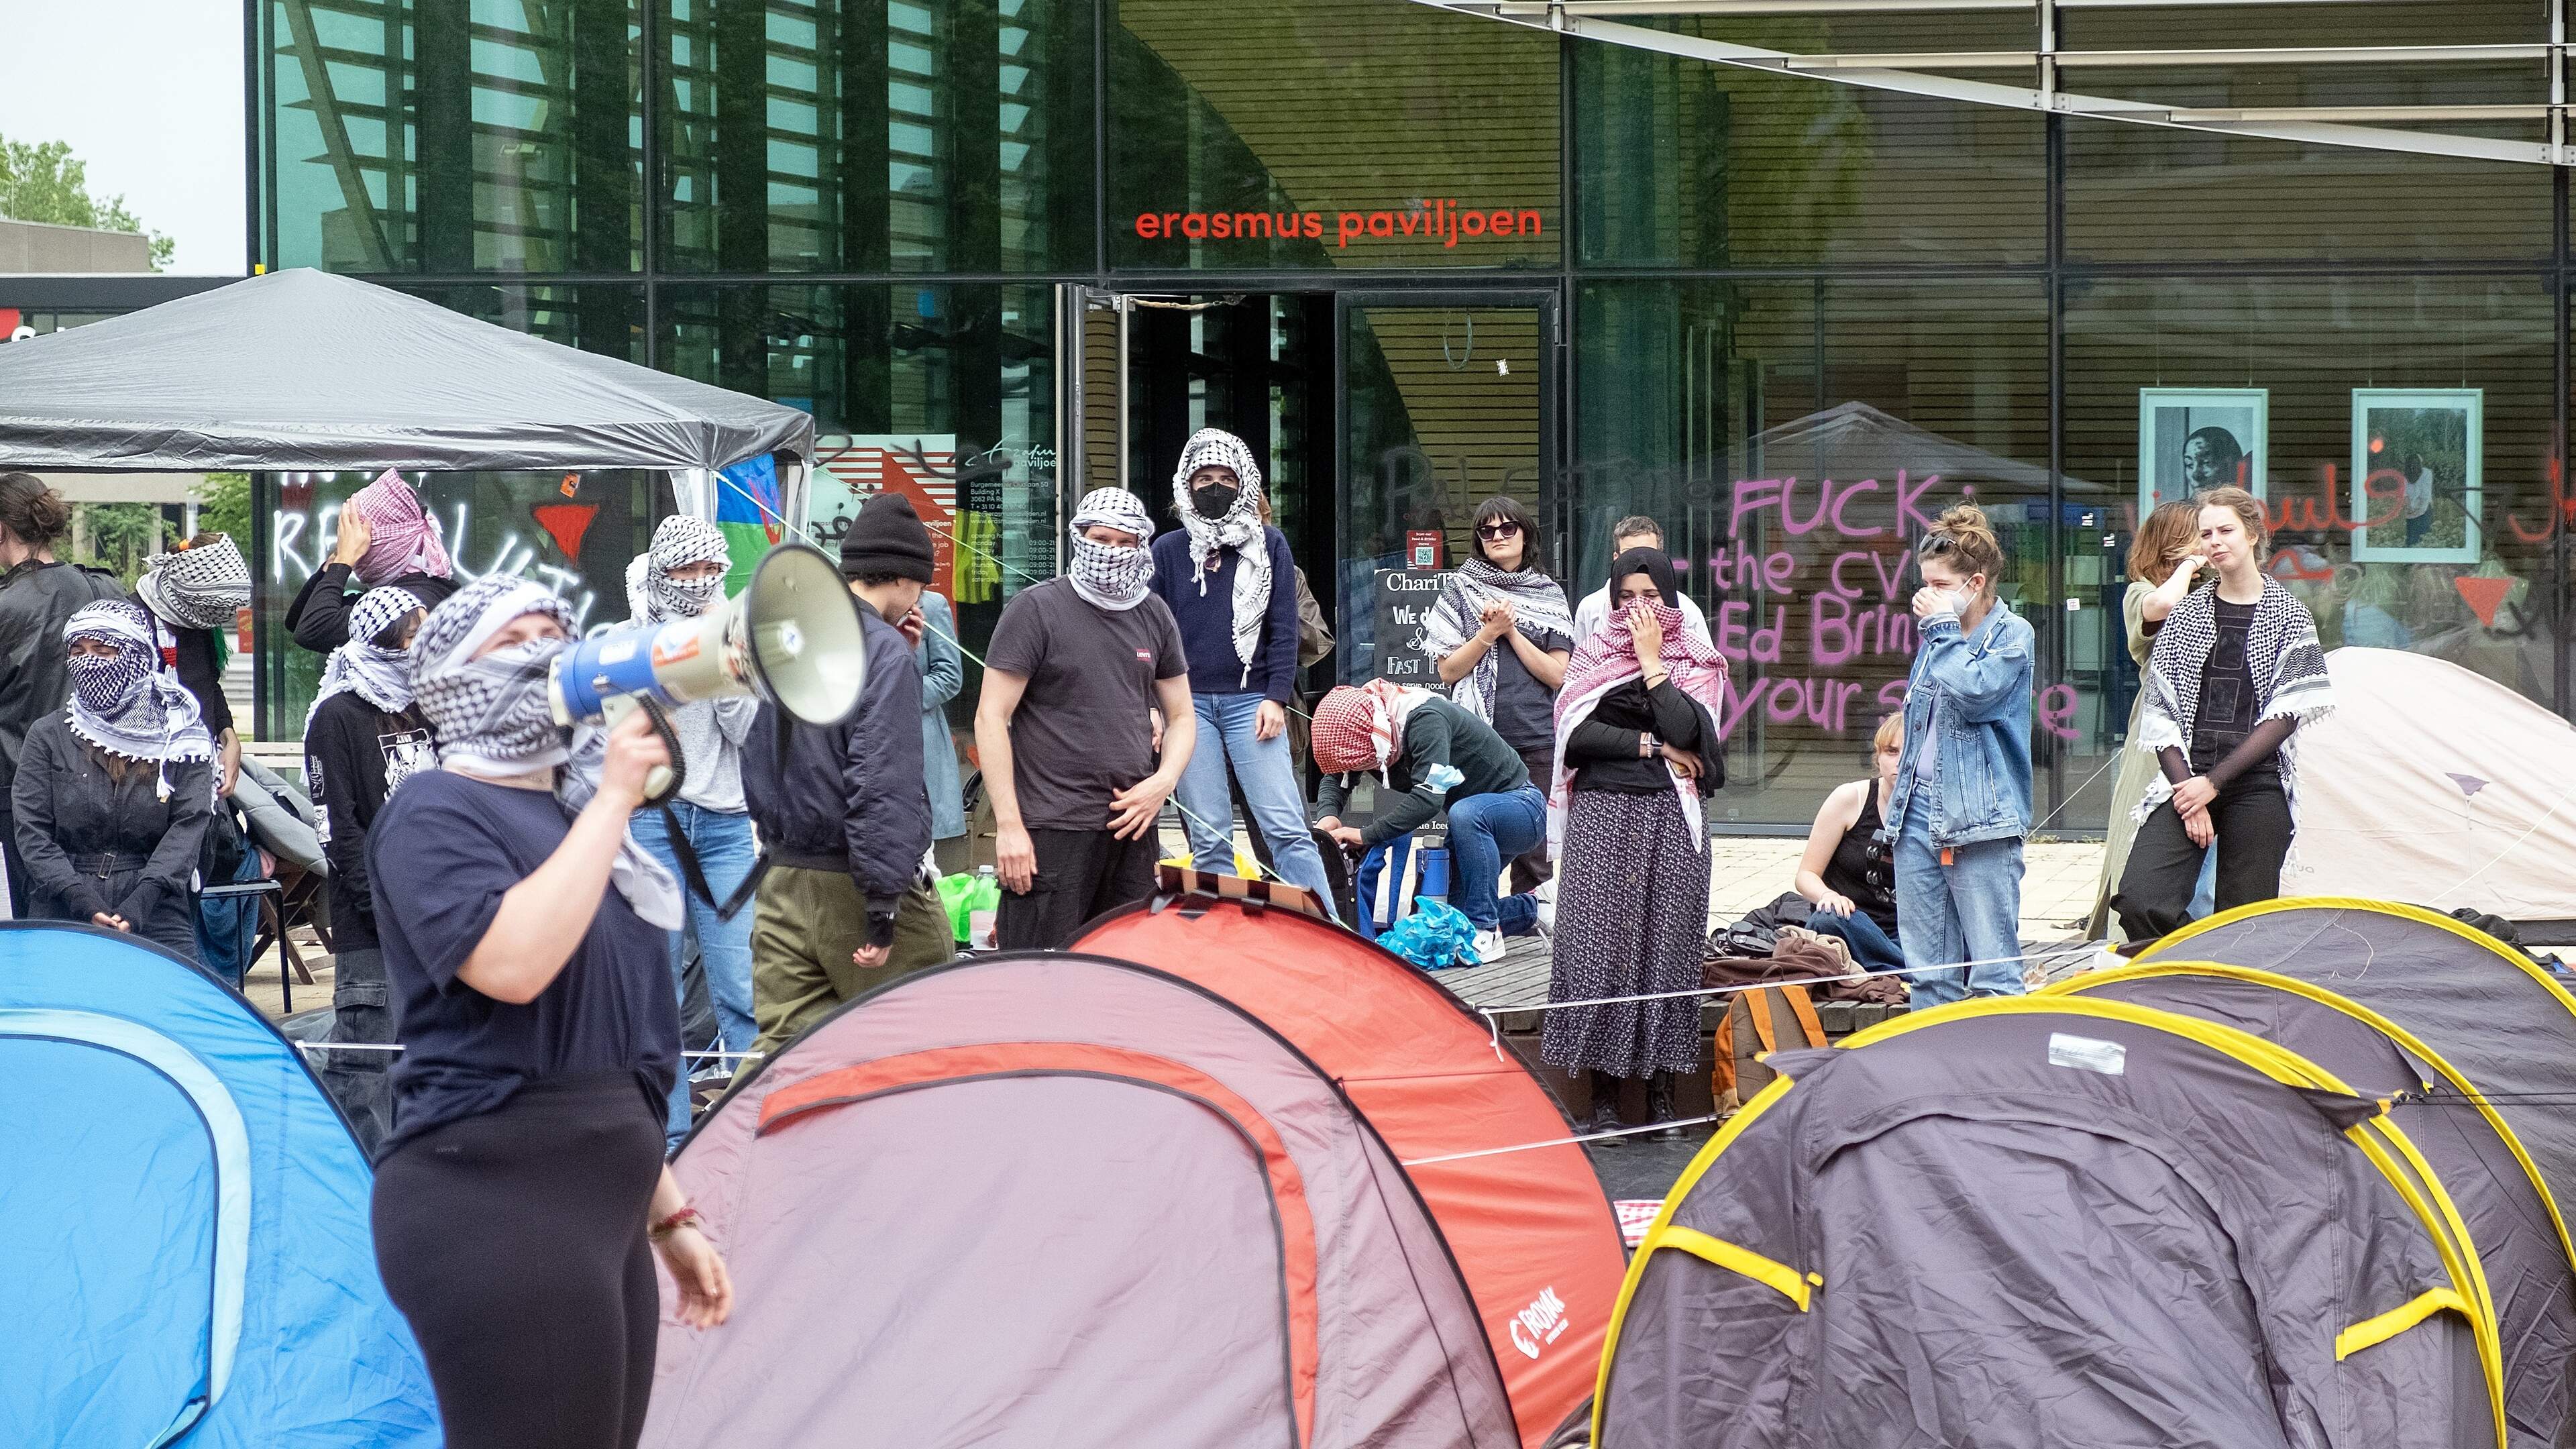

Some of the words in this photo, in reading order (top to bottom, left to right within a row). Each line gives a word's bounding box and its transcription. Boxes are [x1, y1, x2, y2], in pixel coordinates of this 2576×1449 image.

[1135, 210, 1323, 239] erasmus
[1338, 198, 1542, 248] paviljoen
[1014, 458, 1056, 470] paviljoe
[1728, 469, 1939, 537] FUCK
[1386, 572, 1449, 591] ChariT
[1709, 539, 1794, 594] the
[1717, 601, 1784, 663] Ed
[1811, 591, 1922, 664] Brin
[1719, 676, 1862, 741] your
